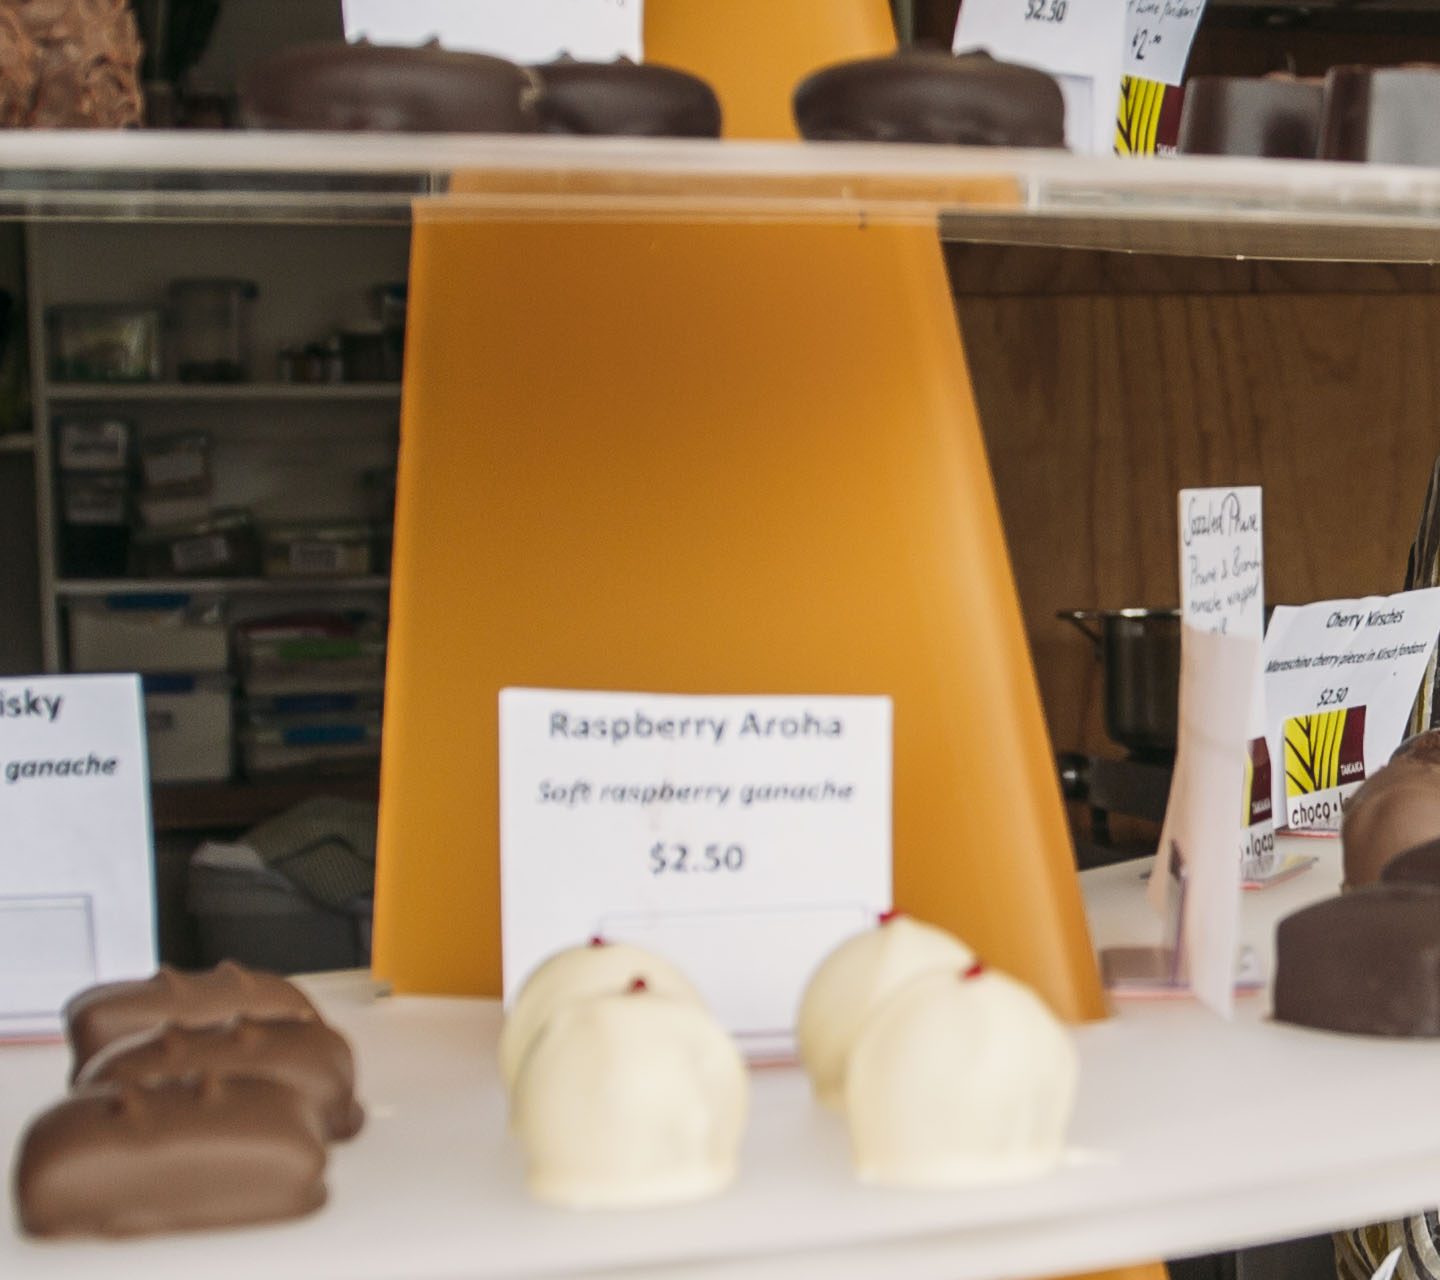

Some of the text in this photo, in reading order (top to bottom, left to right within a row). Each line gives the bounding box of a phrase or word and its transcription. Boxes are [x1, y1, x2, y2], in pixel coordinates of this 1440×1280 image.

[1326, 611, 1362, 631] Cherry
[549, 712, 843, 745] Raspberry Aroha
[5, 753, 119, 783] ganache
[537, 779, 855, 806] Soft raspberry ganache
[1292, 798, 1330, 826] choco
[649, 840, 746, 876] $2.50
